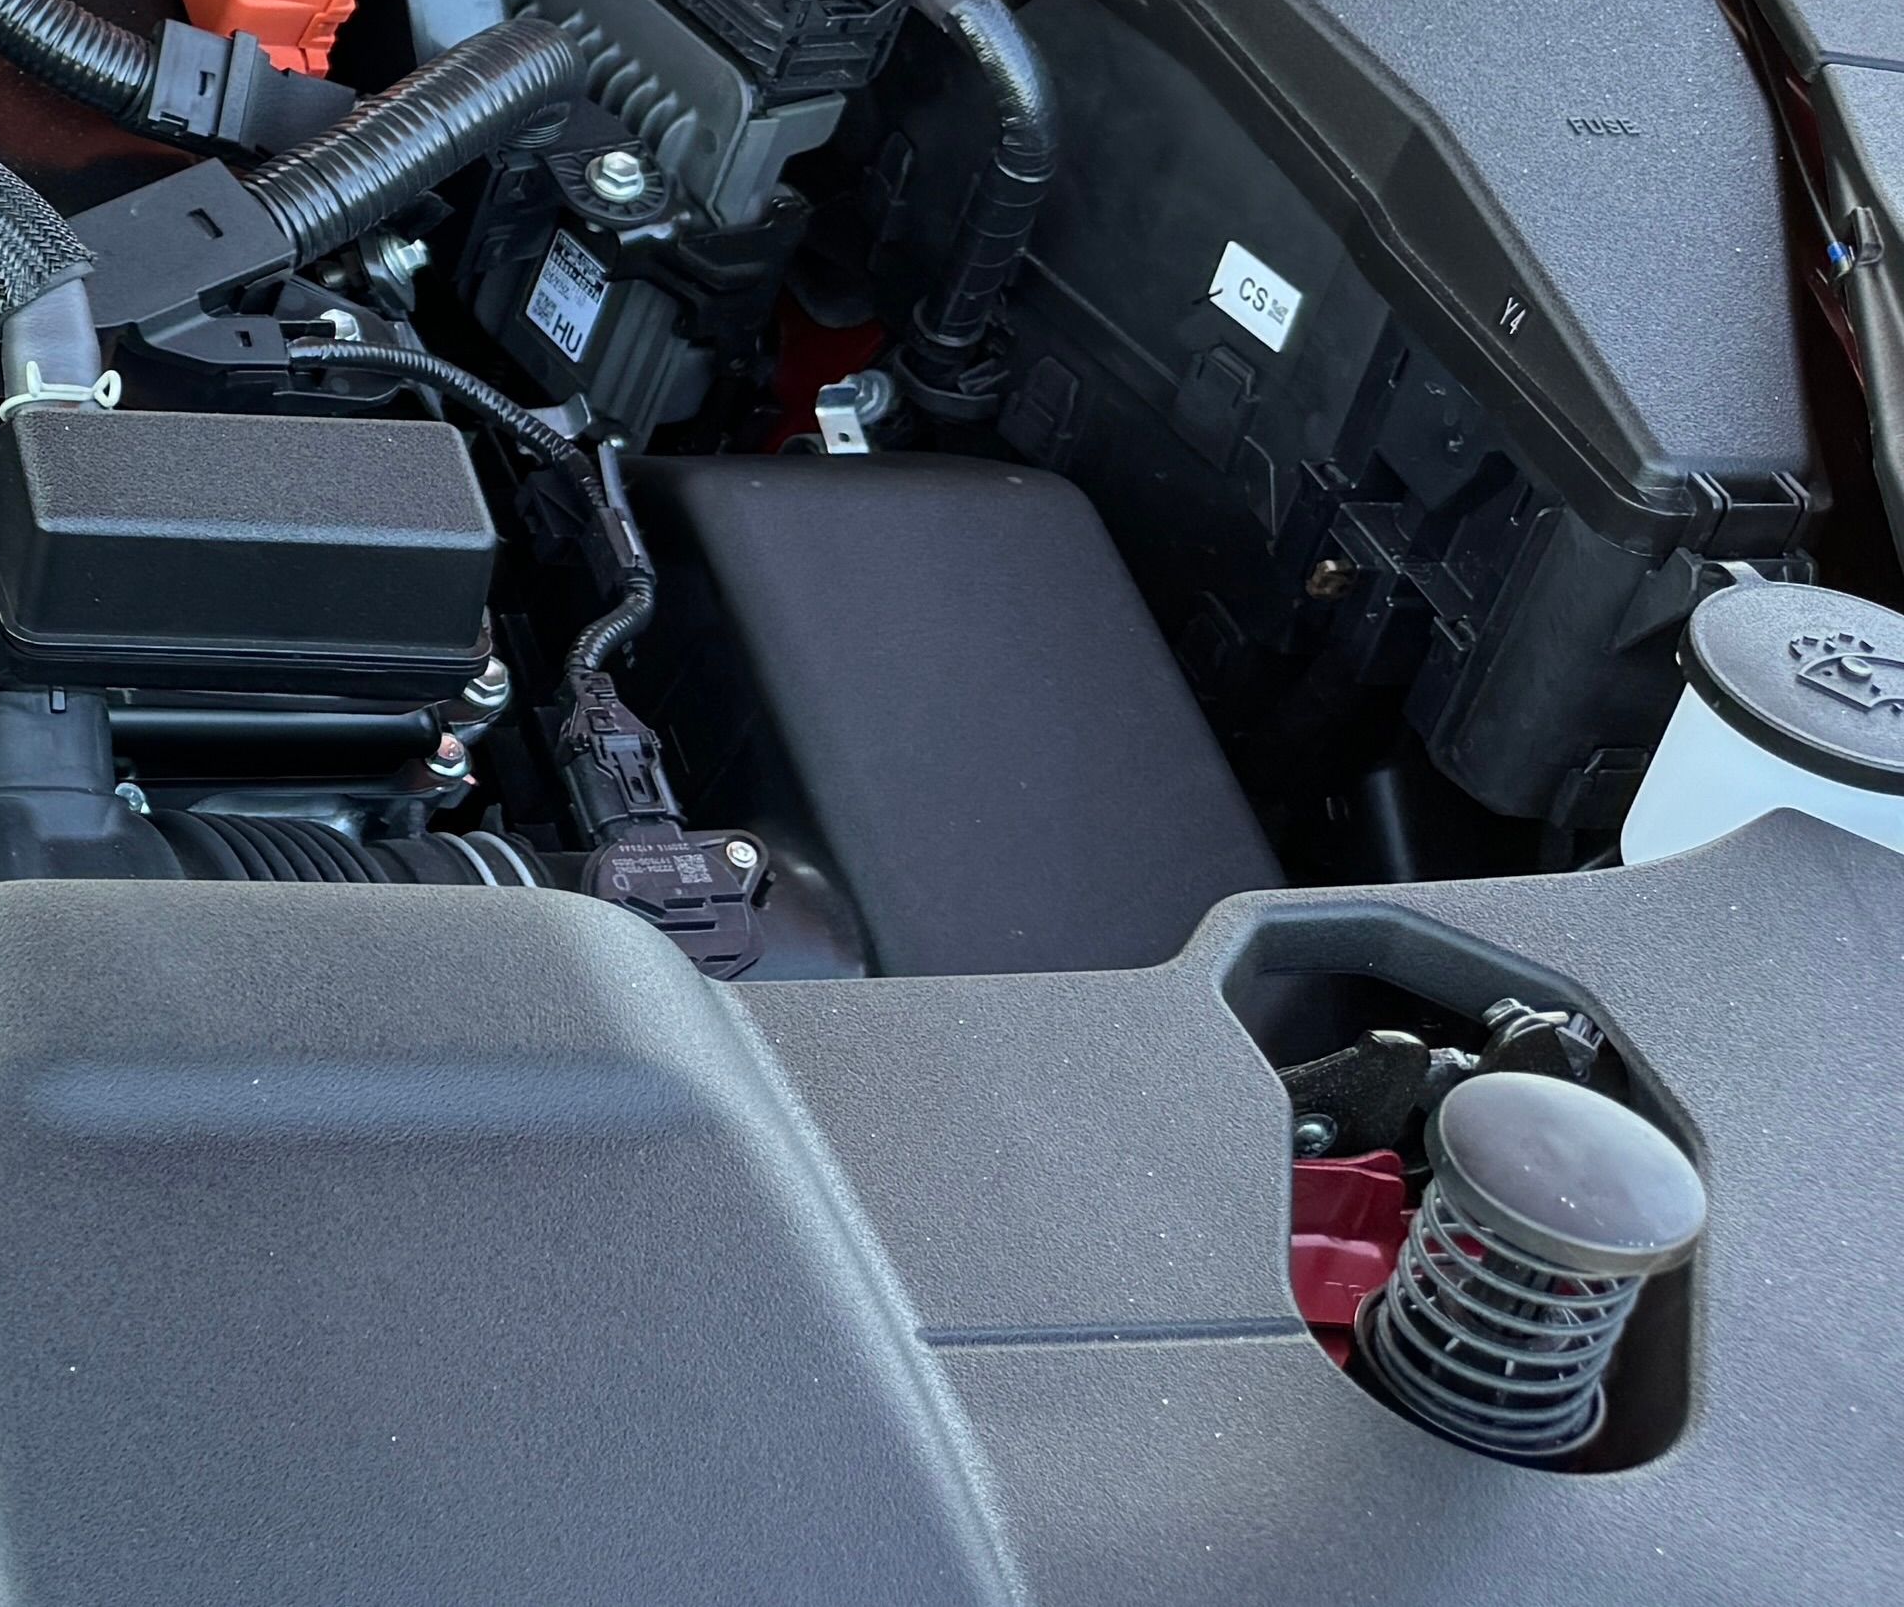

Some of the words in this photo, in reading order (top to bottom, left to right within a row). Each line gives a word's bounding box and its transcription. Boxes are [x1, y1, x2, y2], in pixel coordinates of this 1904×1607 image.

[1565, 115, 1642, 136] FUSE
[1238, 276, 1270, 313] CS
[551, 312, 584, 355] HU
